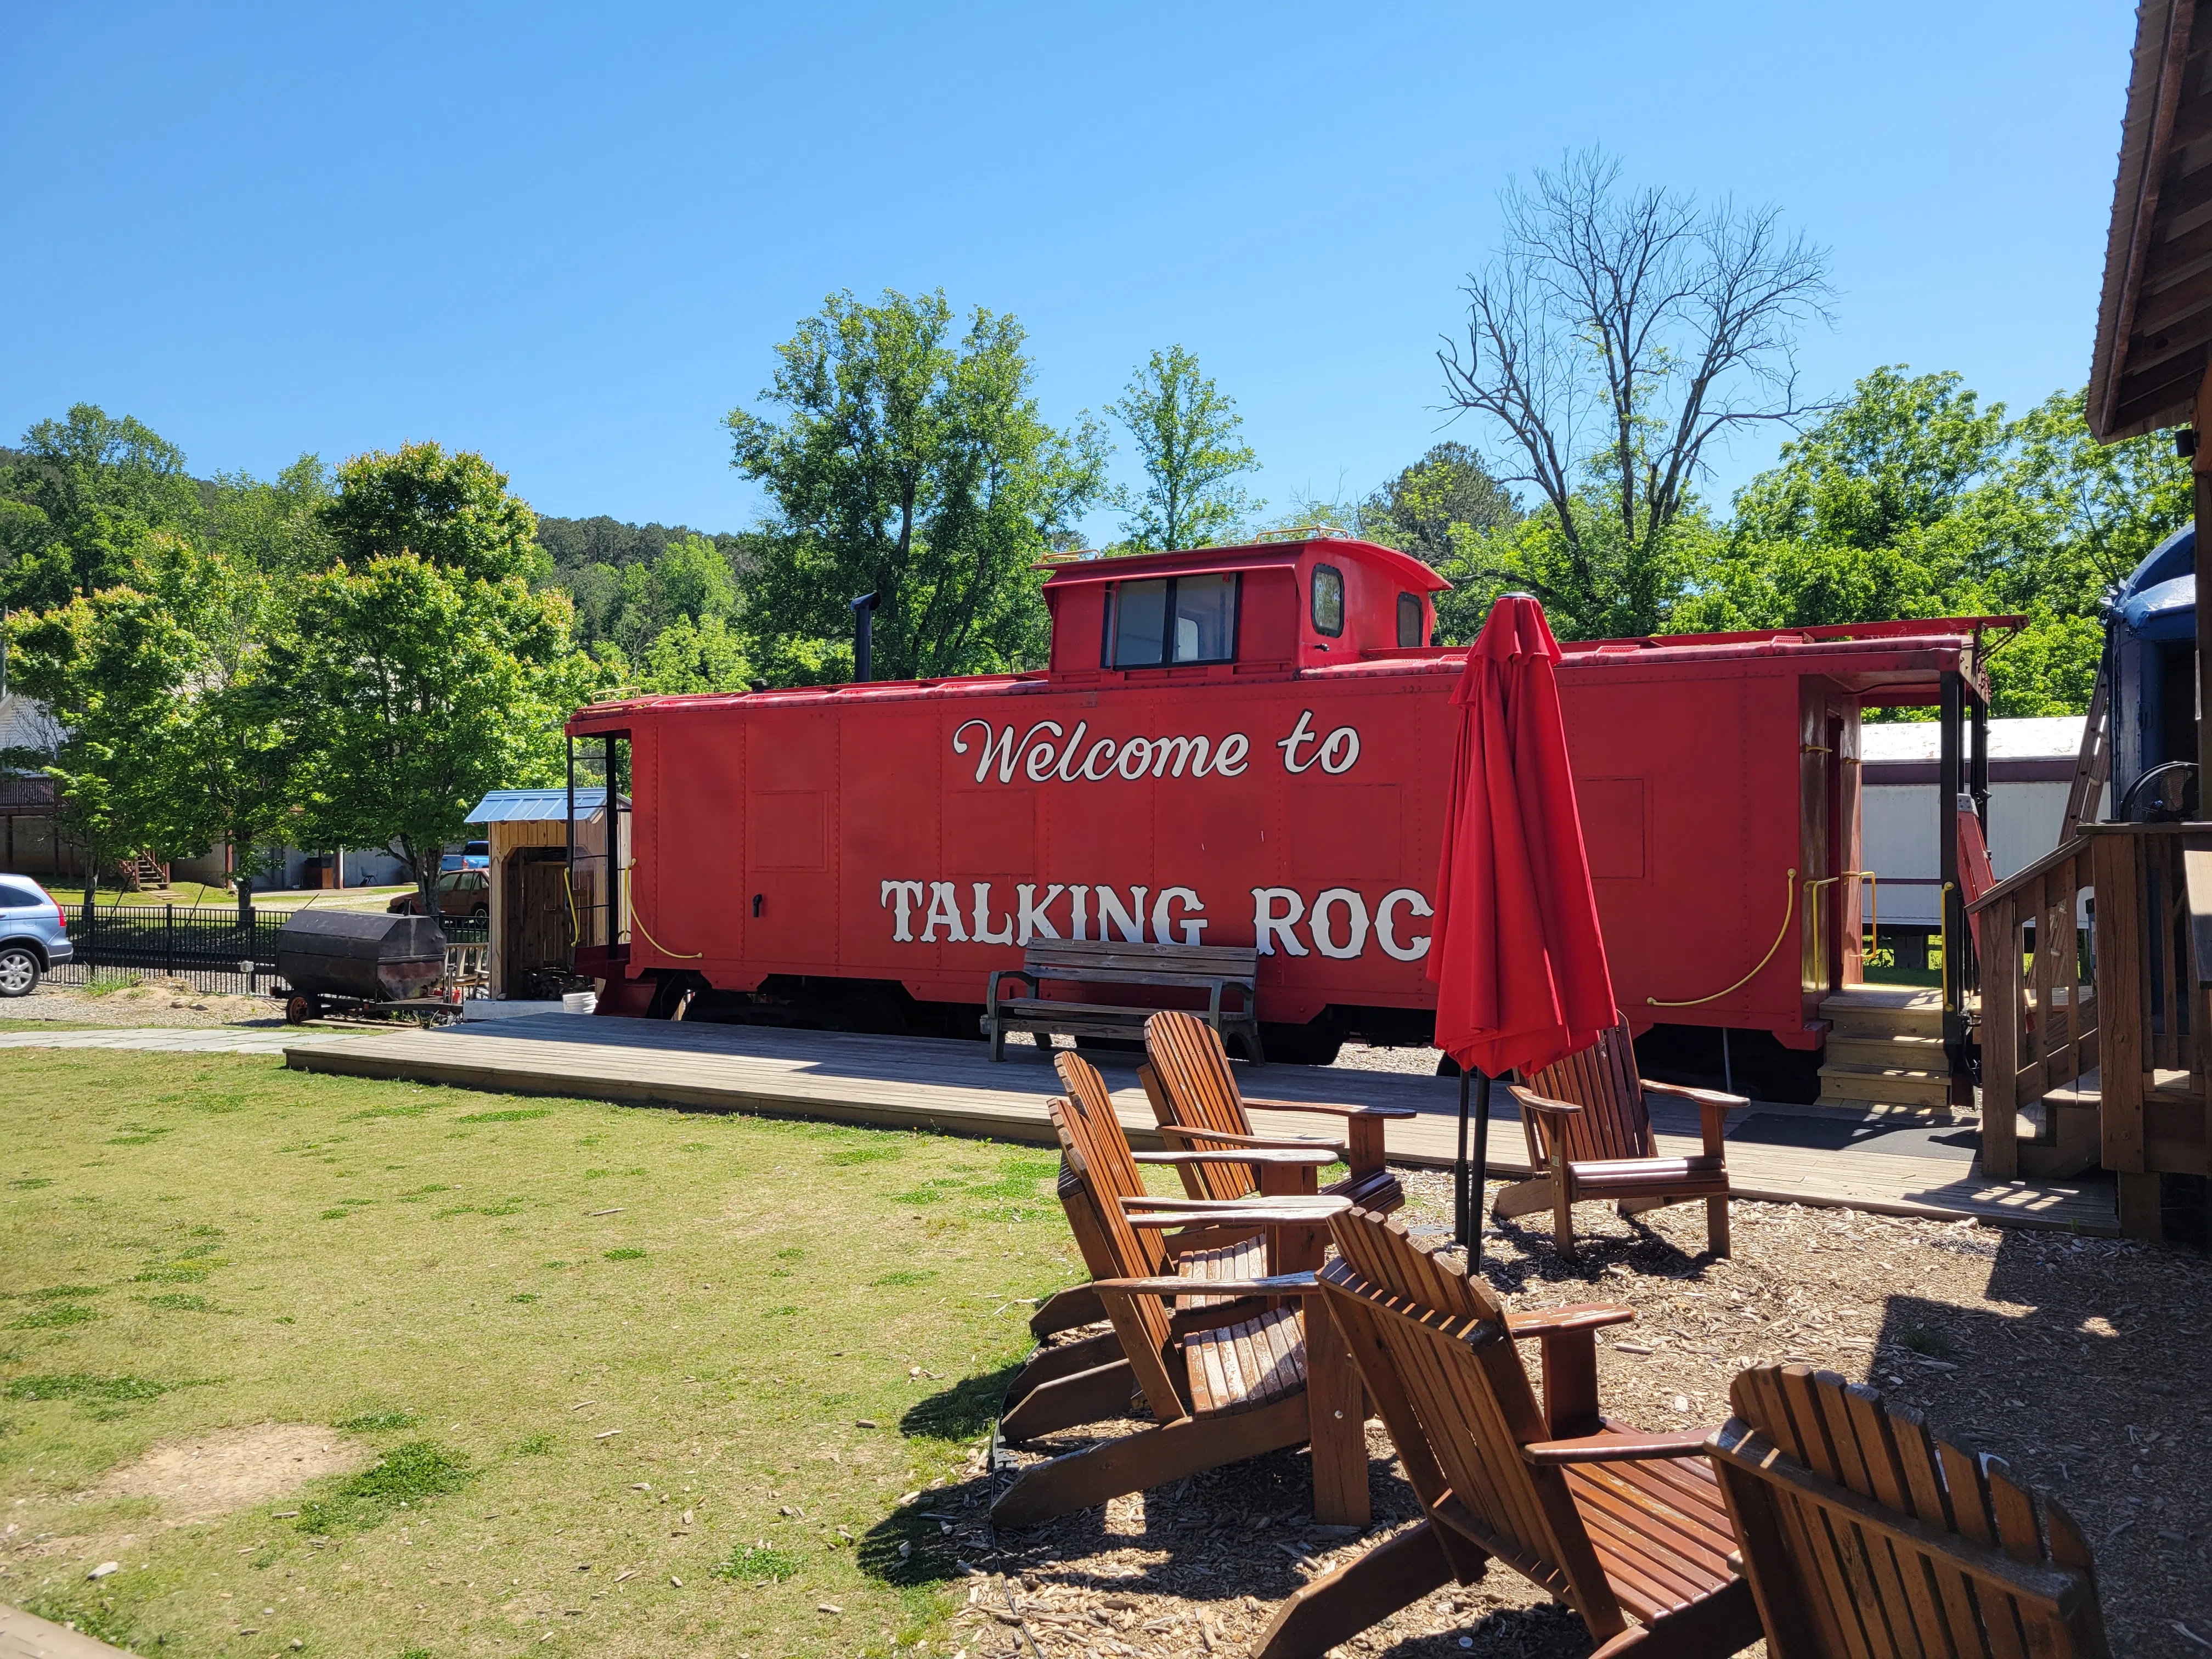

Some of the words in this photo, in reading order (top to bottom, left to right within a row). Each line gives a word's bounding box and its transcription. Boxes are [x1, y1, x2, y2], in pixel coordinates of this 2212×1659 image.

[952, 719, 1250, 785] Welcome
[1277, 709, 1361, 775] to
[880, 879, 1209, 953] TALKING
[1250, 887, 1436, 962] ROC
